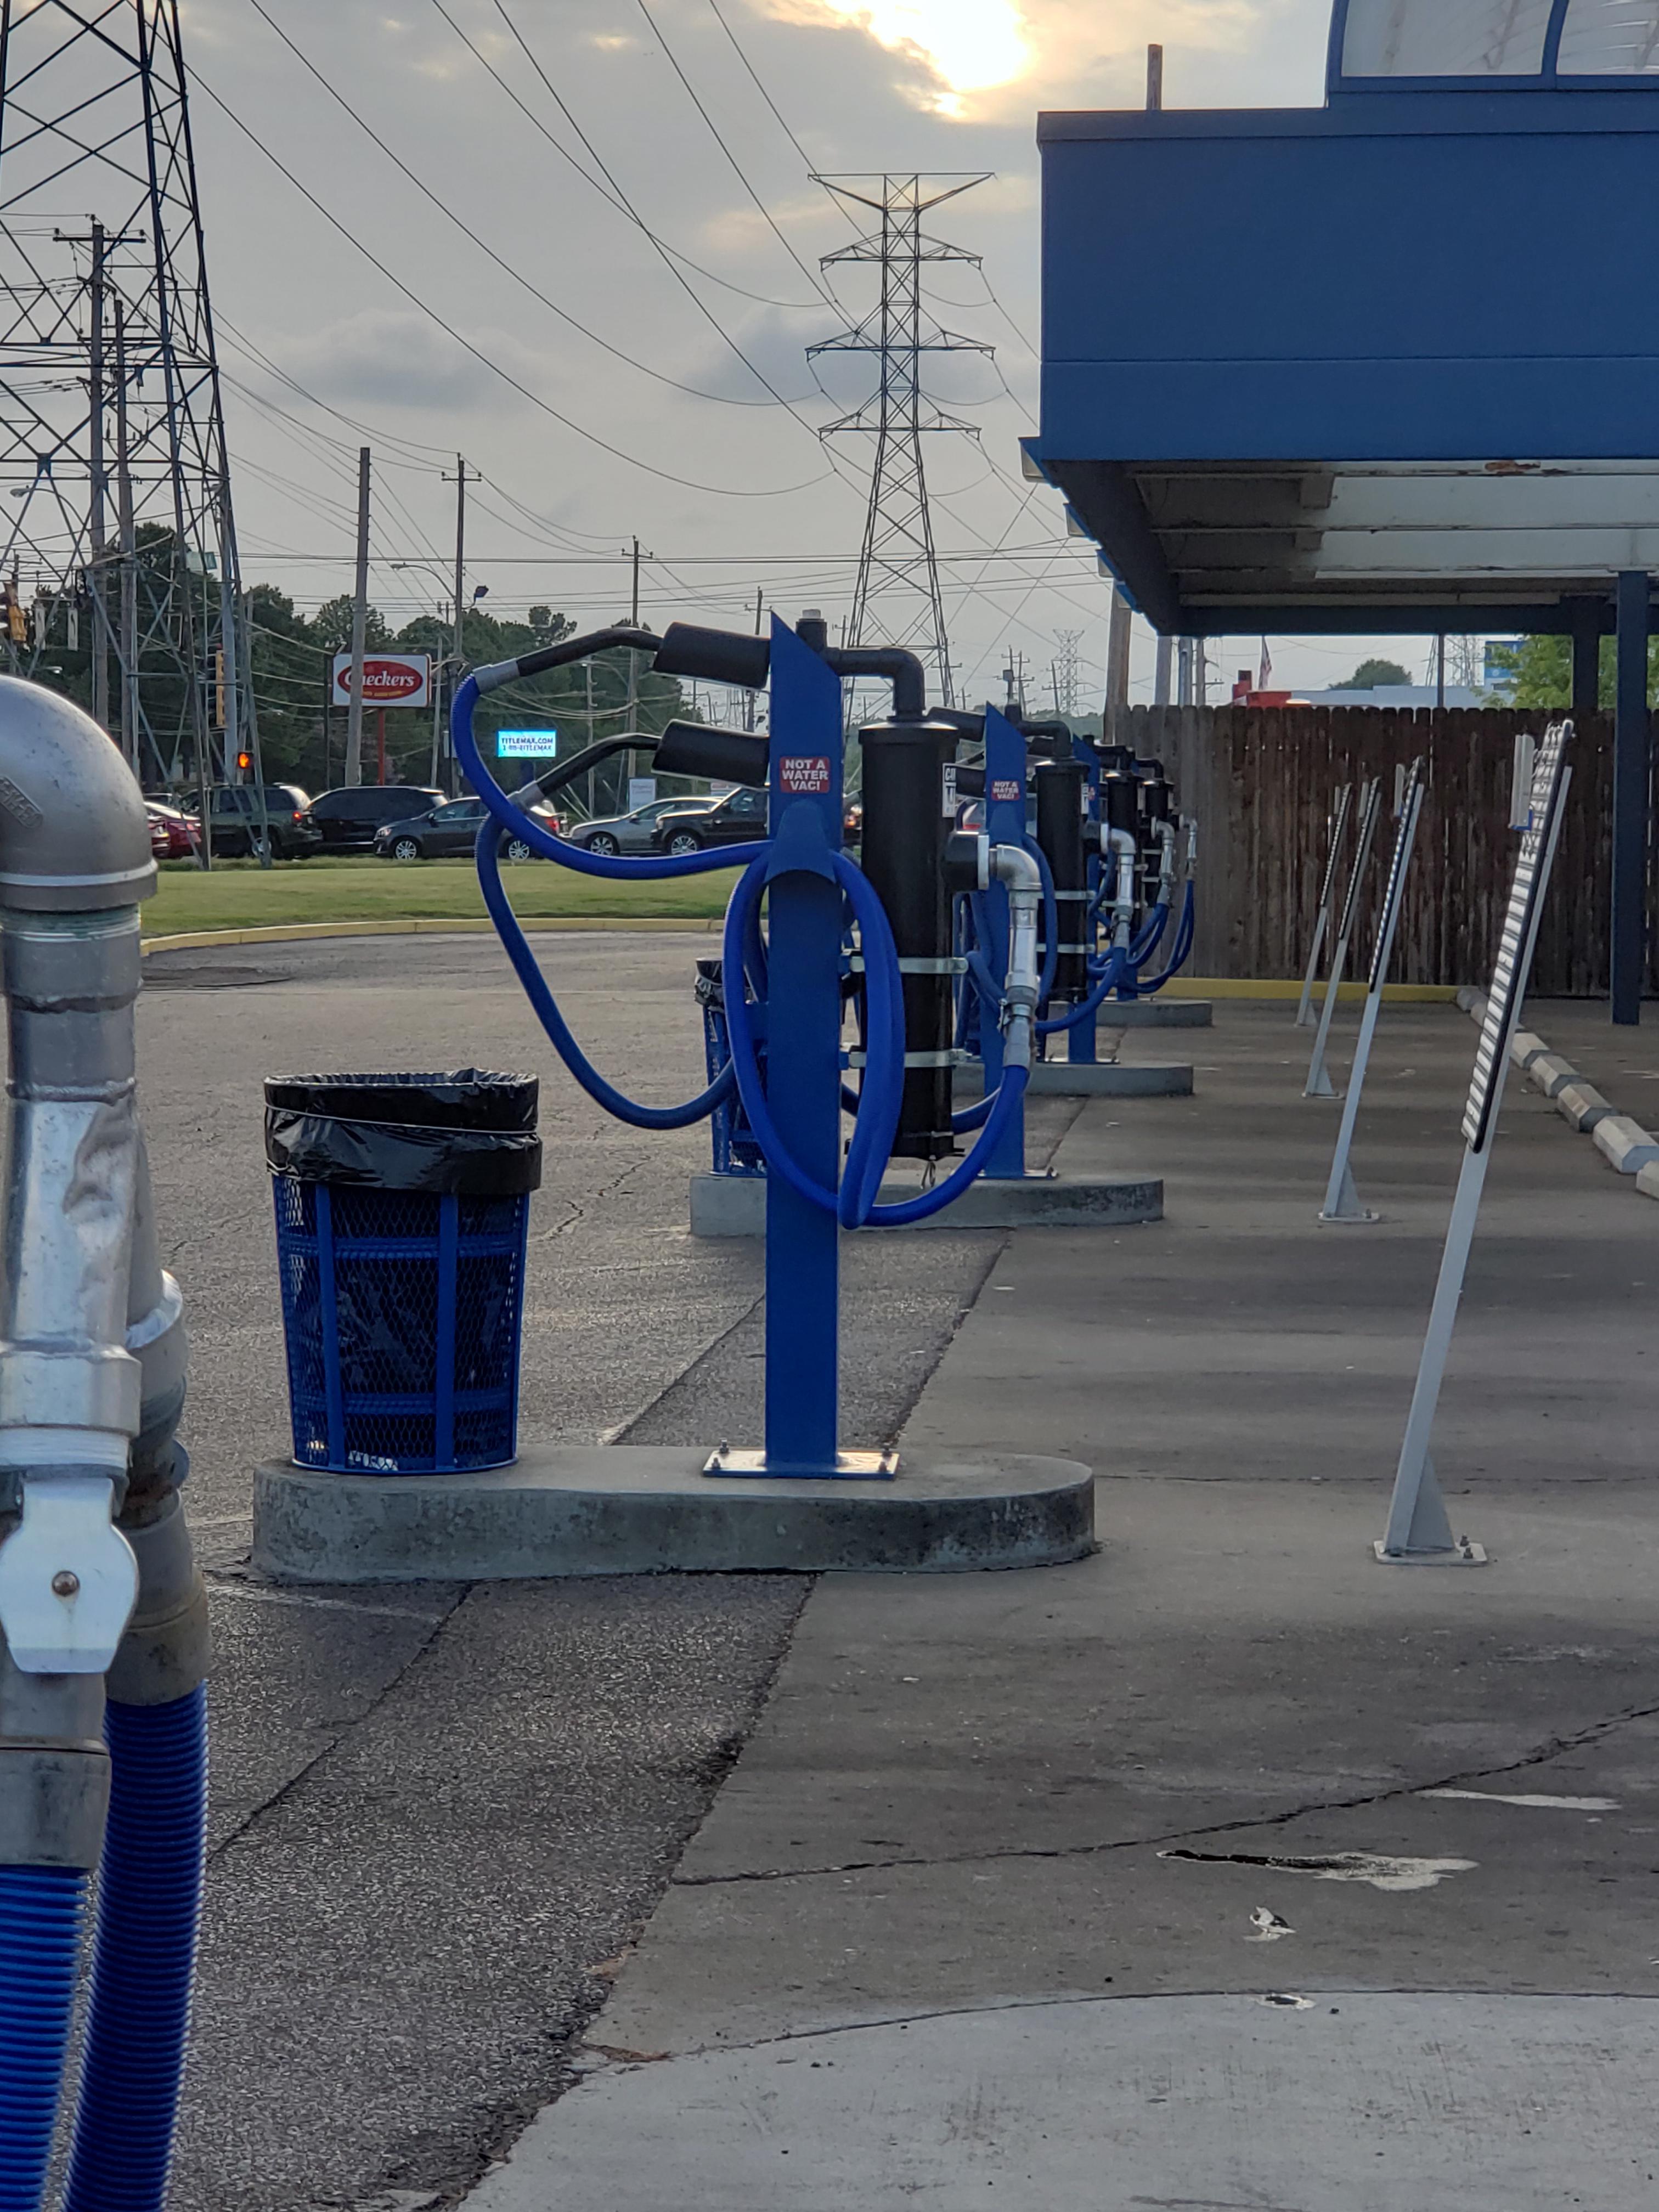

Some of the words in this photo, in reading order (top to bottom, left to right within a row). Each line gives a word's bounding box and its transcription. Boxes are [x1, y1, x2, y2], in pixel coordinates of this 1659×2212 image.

[785, 759, 813, 769] NOT
[816, 759, 826, 769] A
[782, 770, 828, 780] WATER
[790, 781, 821, 791] VAC!
